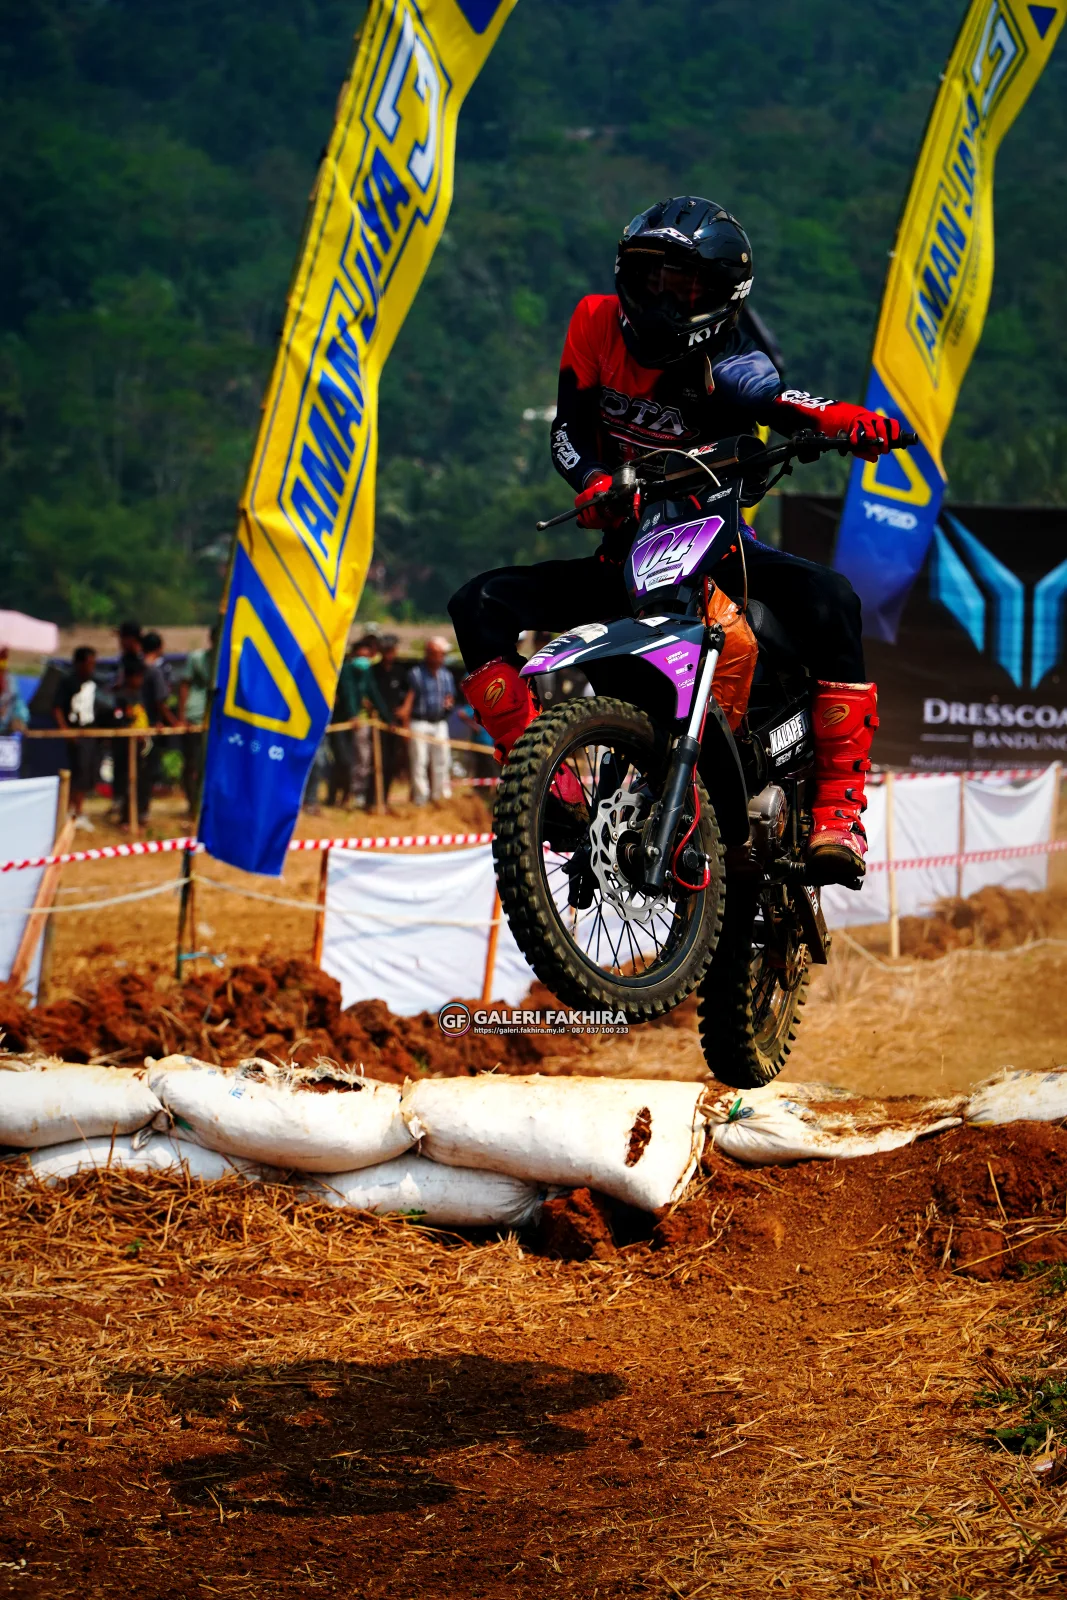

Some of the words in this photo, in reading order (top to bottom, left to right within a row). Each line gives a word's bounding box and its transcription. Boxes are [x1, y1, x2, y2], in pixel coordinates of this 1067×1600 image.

[916, 203, 967, 352] AMAN
[290, 313, 364, 560] AMAN
[636, 520, 707, 578] 04
